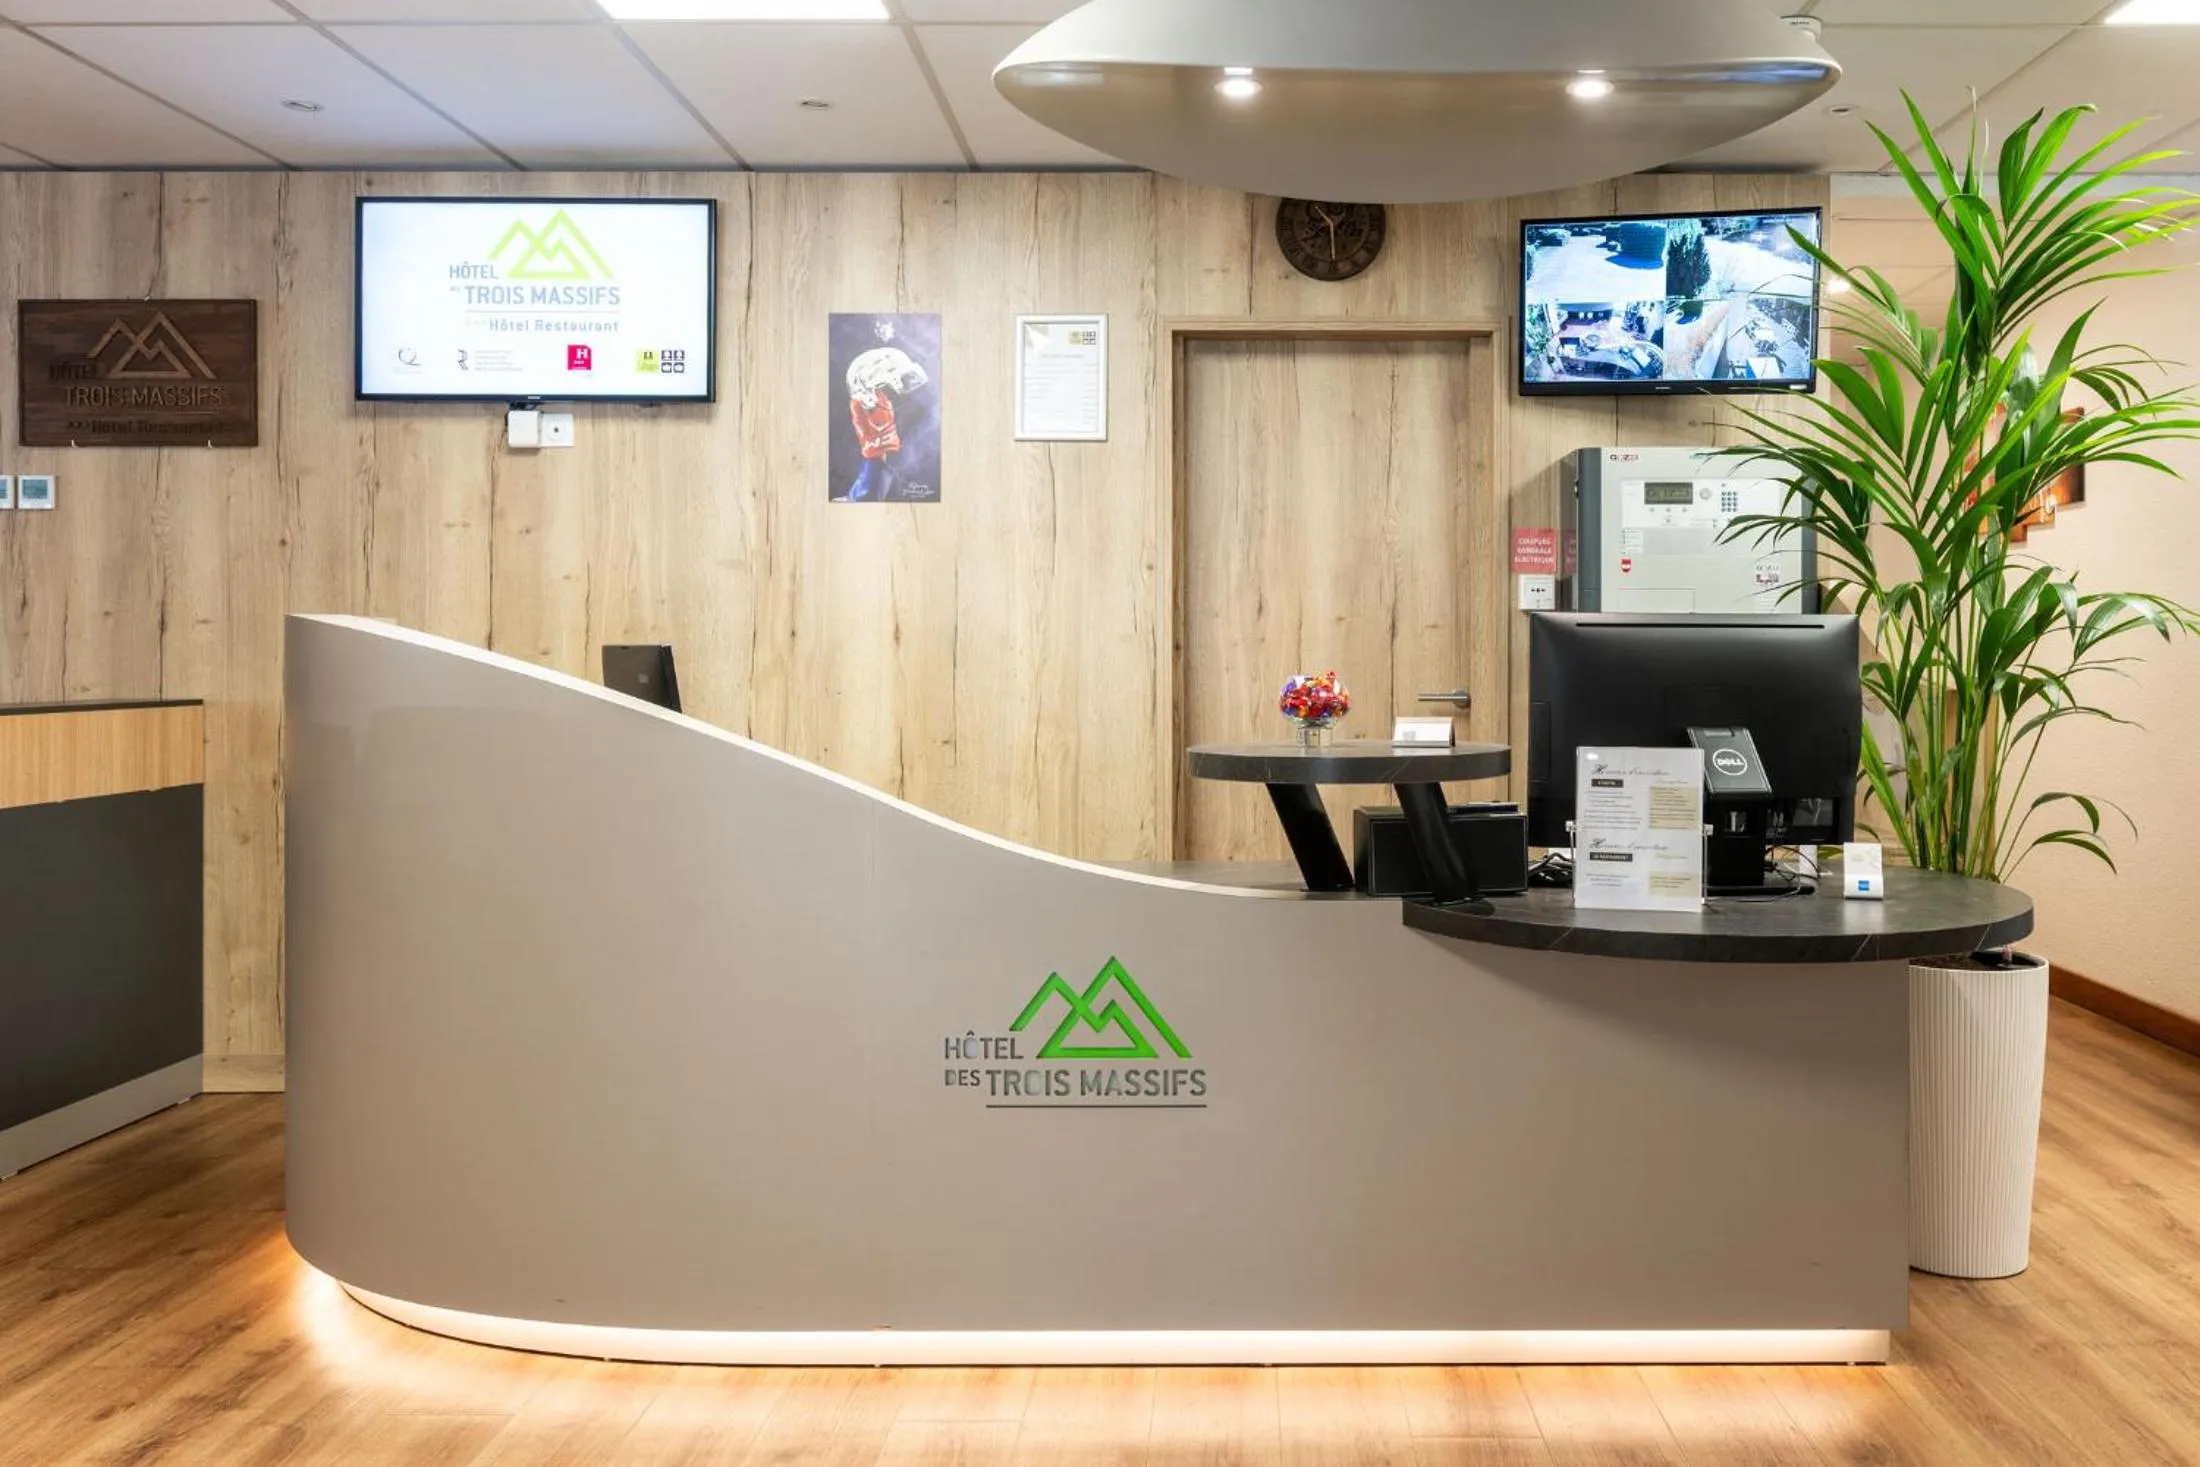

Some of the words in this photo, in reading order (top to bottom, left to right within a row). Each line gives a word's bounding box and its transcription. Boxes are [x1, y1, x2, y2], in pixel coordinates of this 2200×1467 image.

[449, 260, 499, 280] HÔTEL
[464, 285, 525, 305] TROIS
[531, 285, 621, 306] MASSIFS
[489, 317, 530, 332] Hôtel
[64, 385, 126, 407] TROIS
[131, 385, 224, 407] MASSIFS
[1717, 758, 1745, 766] DELL
[944, 1030, 1024, 1060] HÔTEL
[944, 1069, 981, 1087] DES
[986, 1069, 1071, 1097] TROIS
[1080, 1069, 1207, 1097] MASSIFS
